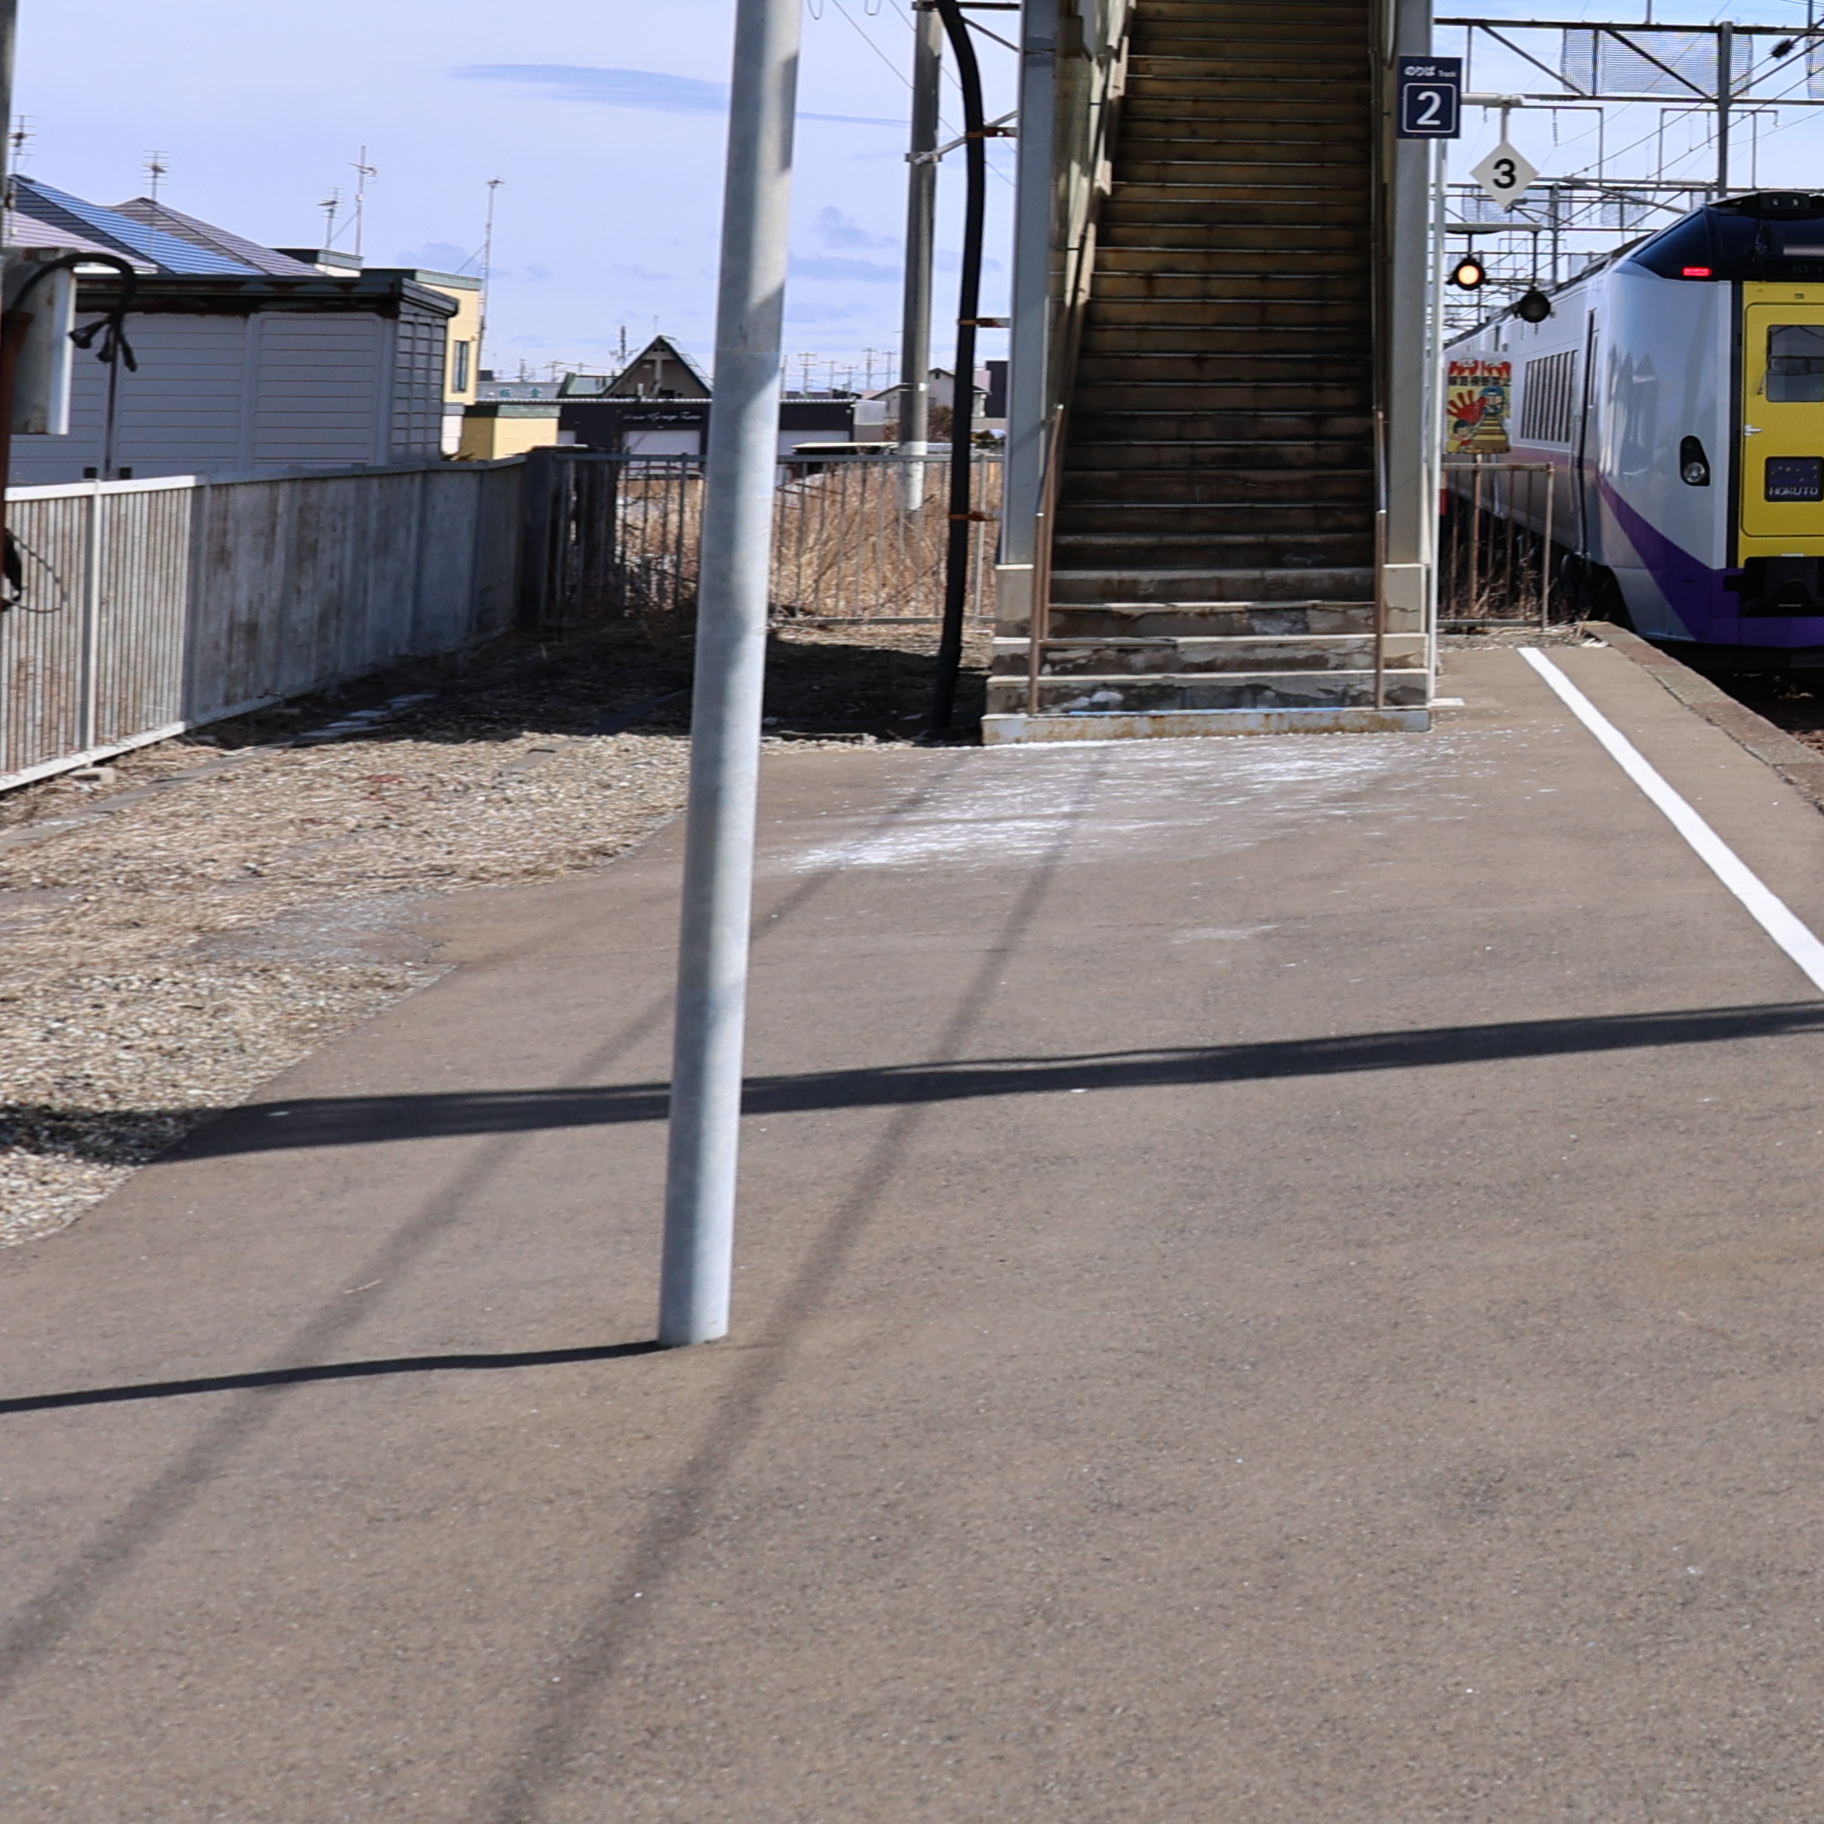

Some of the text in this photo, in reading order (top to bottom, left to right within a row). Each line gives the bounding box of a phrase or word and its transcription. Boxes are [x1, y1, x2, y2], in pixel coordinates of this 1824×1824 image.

[1404, 66, 1436, 77] のりば
[1416, 91, 1441, 125] 2
[1493, 158, 1516, 189] 3
[1769, 486, 1819, 495] HOKUTO
